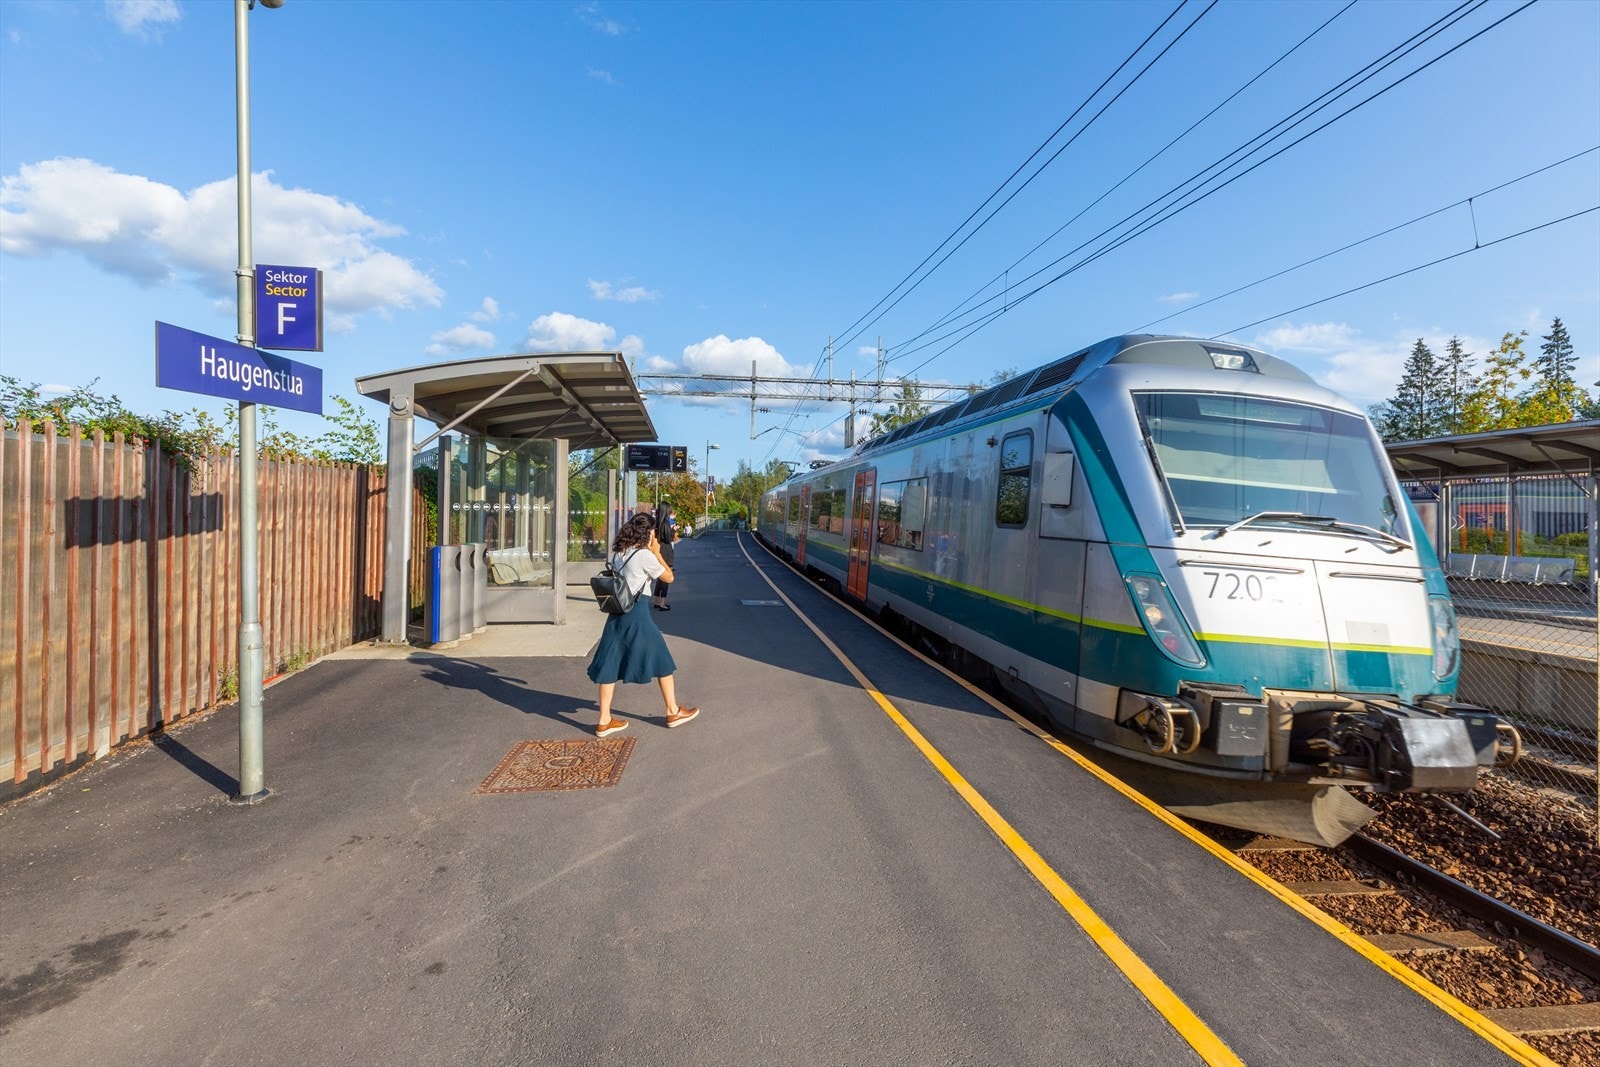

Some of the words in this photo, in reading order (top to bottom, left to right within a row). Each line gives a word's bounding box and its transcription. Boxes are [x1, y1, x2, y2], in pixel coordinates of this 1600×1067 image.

[265, 269, 308, 284] Sektor
[265, 284, 307, 297] Sector
[277, 303, 297, 335] F
[201, 345, 303, 396] Haugenstua
[676, 458, 683, 467] 2
